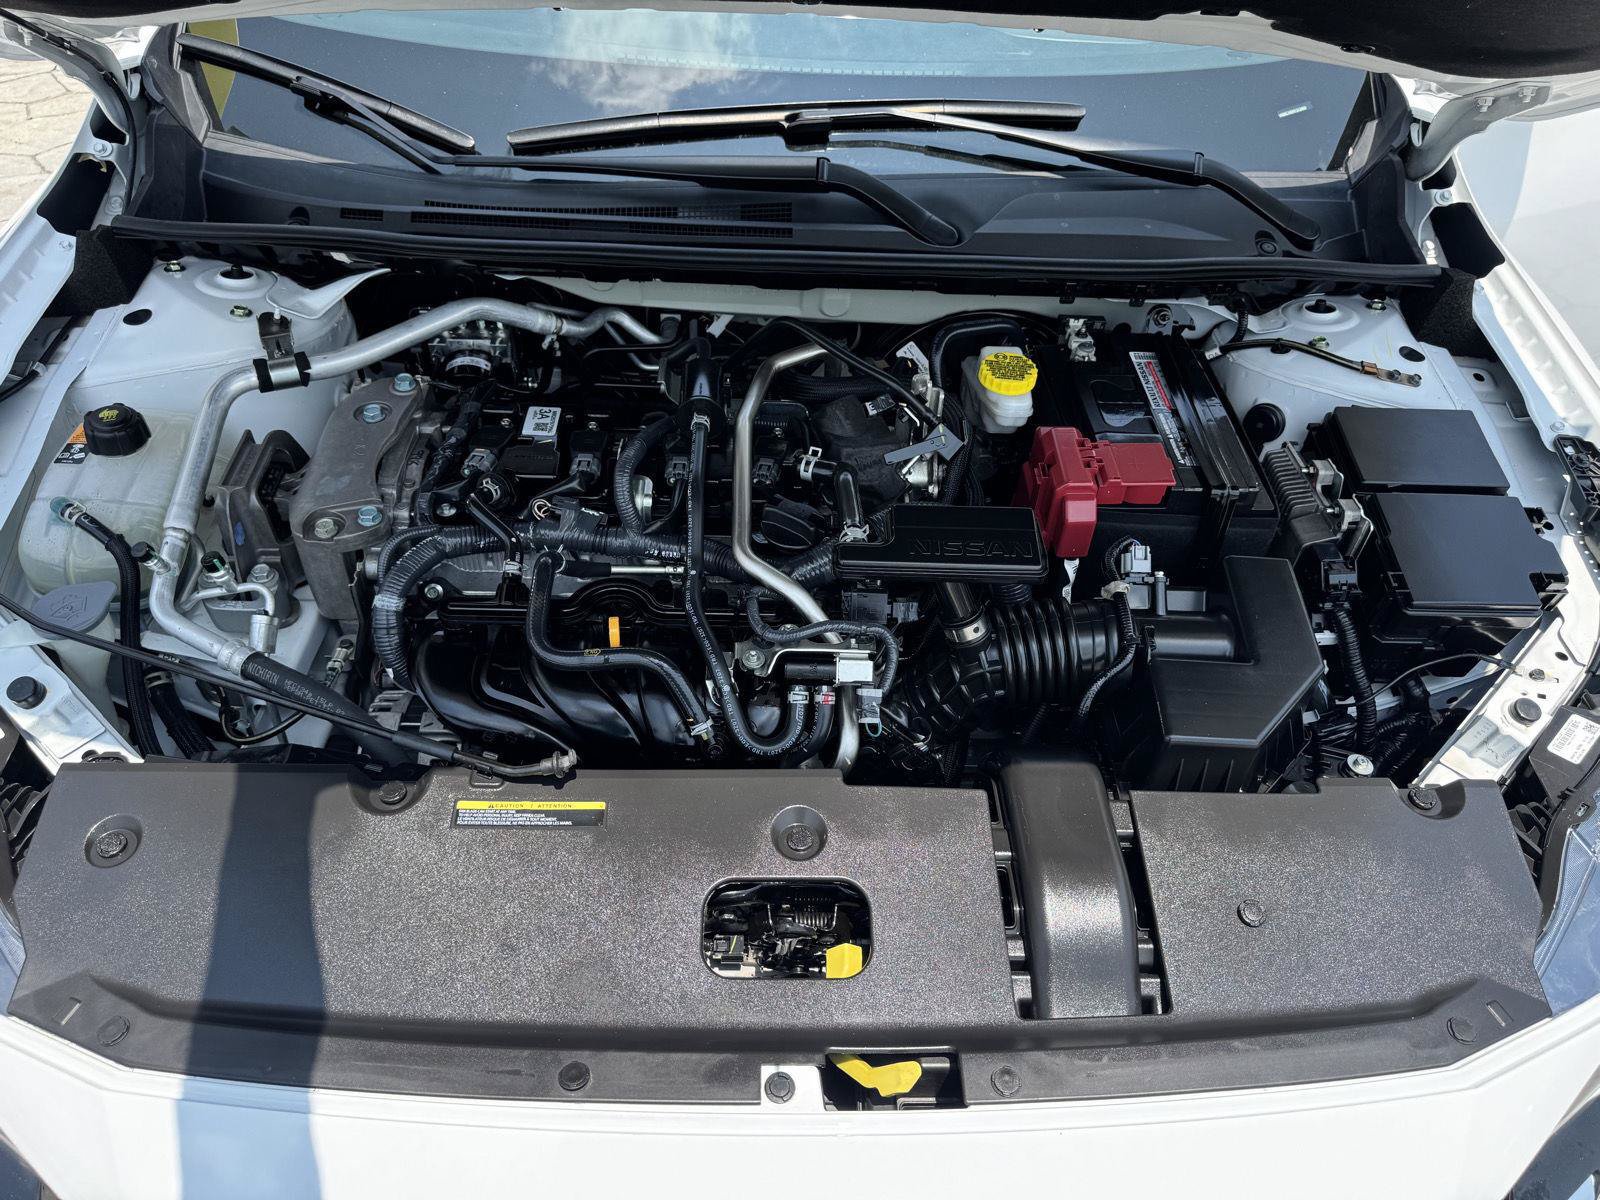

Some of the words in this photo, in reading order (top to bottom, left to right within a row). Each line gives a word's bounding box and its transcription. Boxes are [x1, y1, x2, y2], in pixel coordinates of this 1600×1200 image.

[1135, 361, 1151, 386] NISSAN
[537, 408, 552, 420] 3A
[909, 537, 1033, 558] NISSAN
[247, 662, 280, 685] NICHIRIN
